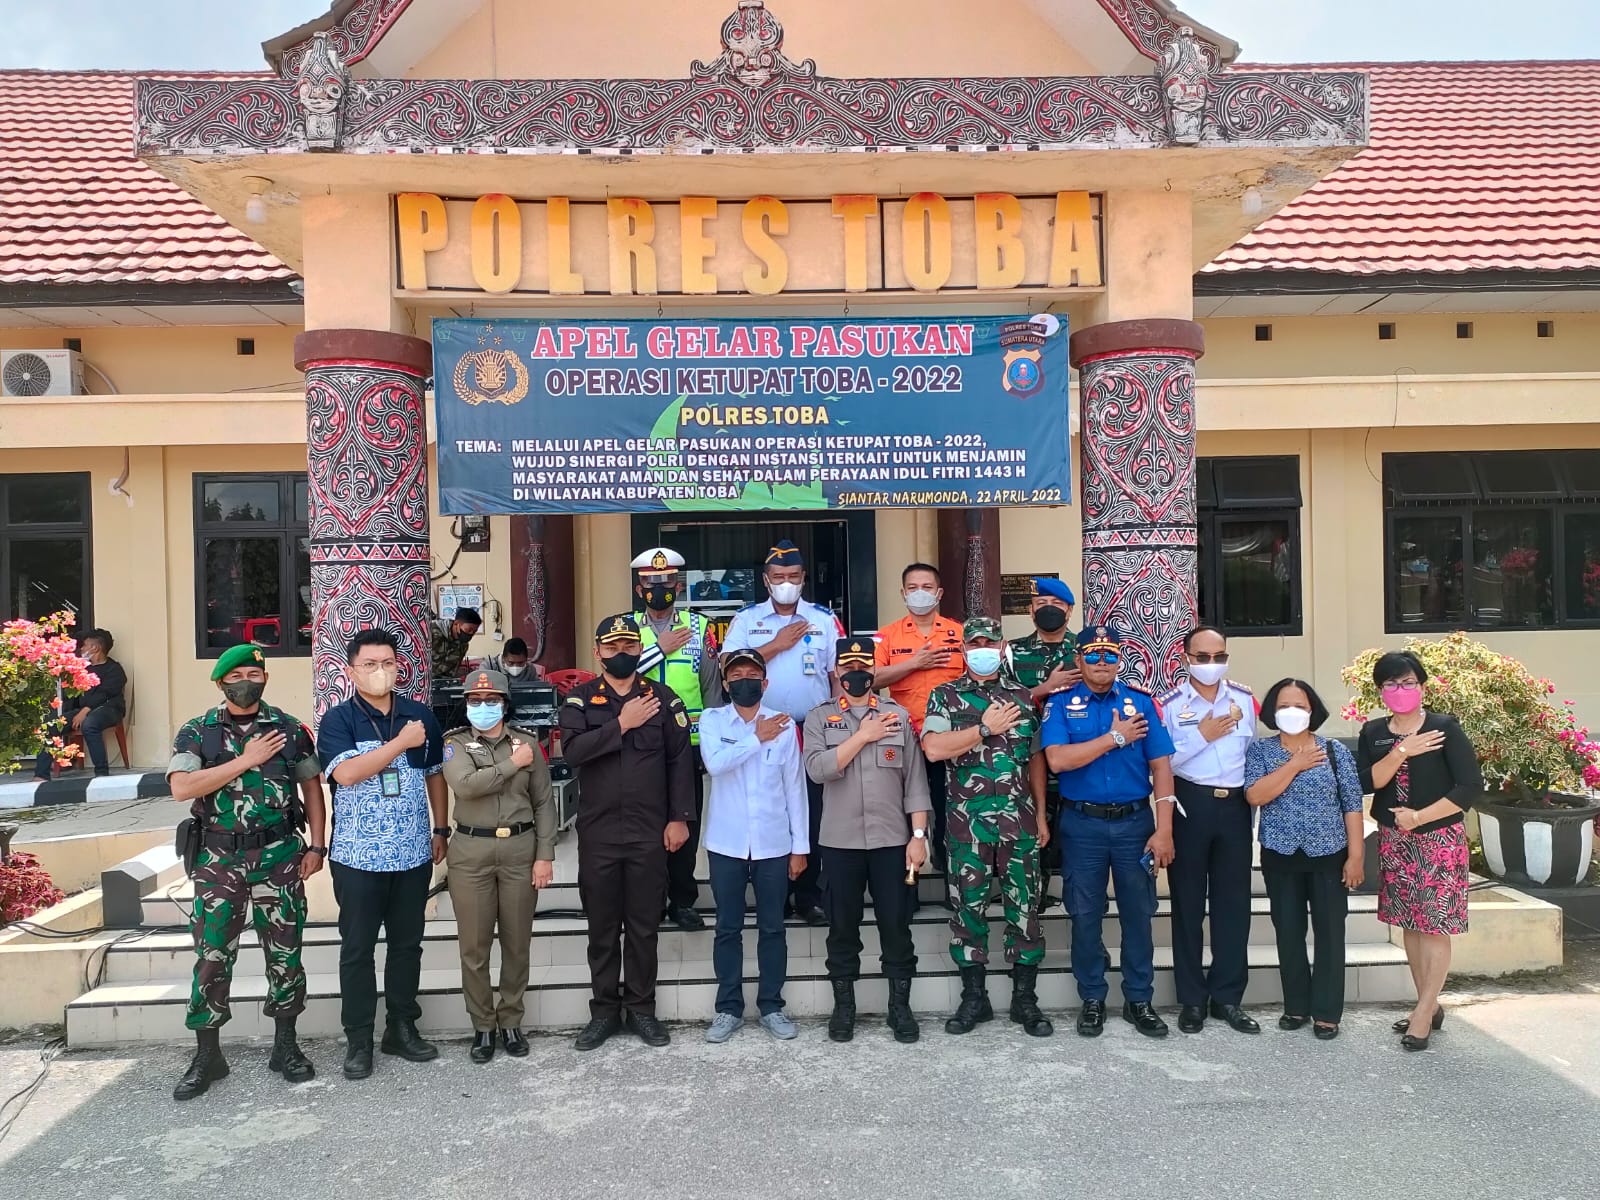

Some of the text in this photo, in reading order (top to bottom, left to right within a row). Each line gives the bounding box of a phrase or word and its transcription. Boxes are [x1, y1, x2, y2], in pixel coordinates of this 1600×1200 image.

[397, 190, 1104, 295] POLRES TOBA
[531, 324, 975, 360] APEL GELAR PASUKAN
[1000, 335, 1045, 346] SUMATERA UTARA
[545, 368, 670, 396] OPERASI
[676, 366, 797, 395] KETUPAT
[800, 366, 874, 394] TOBA
[892, 365, 962, 392] 2022
[680, 406, 829, 426] POLRES TOBA
[456, 440, 502, 453] TEMA:
[512, 439, 580, 453] MELALUI
[582, 439, 622, 452] APEL
[625, 438, 676, 452] GELAR
[679, 438, 751, 451] PASUKAN
[754, 437, 822, 450] OPERASI
[825, 436, 891, 449] KETUPAT
[894, 435, 933, 448] TOBA
[944, 435, 987, 449] 2022,
[512, 449, 1026, 469] WUJUD SINERGI POLRI DENGAN INSTANSI TERKAIT UNTUK MENJAMIN
[513, 465, 1026, 485] MASYARAKAT AMAN DAN SEHAT DALAM PERAYAAN IDUL FITRI 1443 H
[513, 485, 738, 501] DI WILAYAH KABUPATEN TOBA
[838, 492, 889, 506] SIANTAR
[976, 490, 991, 504] 22
[994, 489, 1029, 503] APRIL
[1031, 489, 1062, 502] 2022
[823, 722, 849, 730] AKALA
